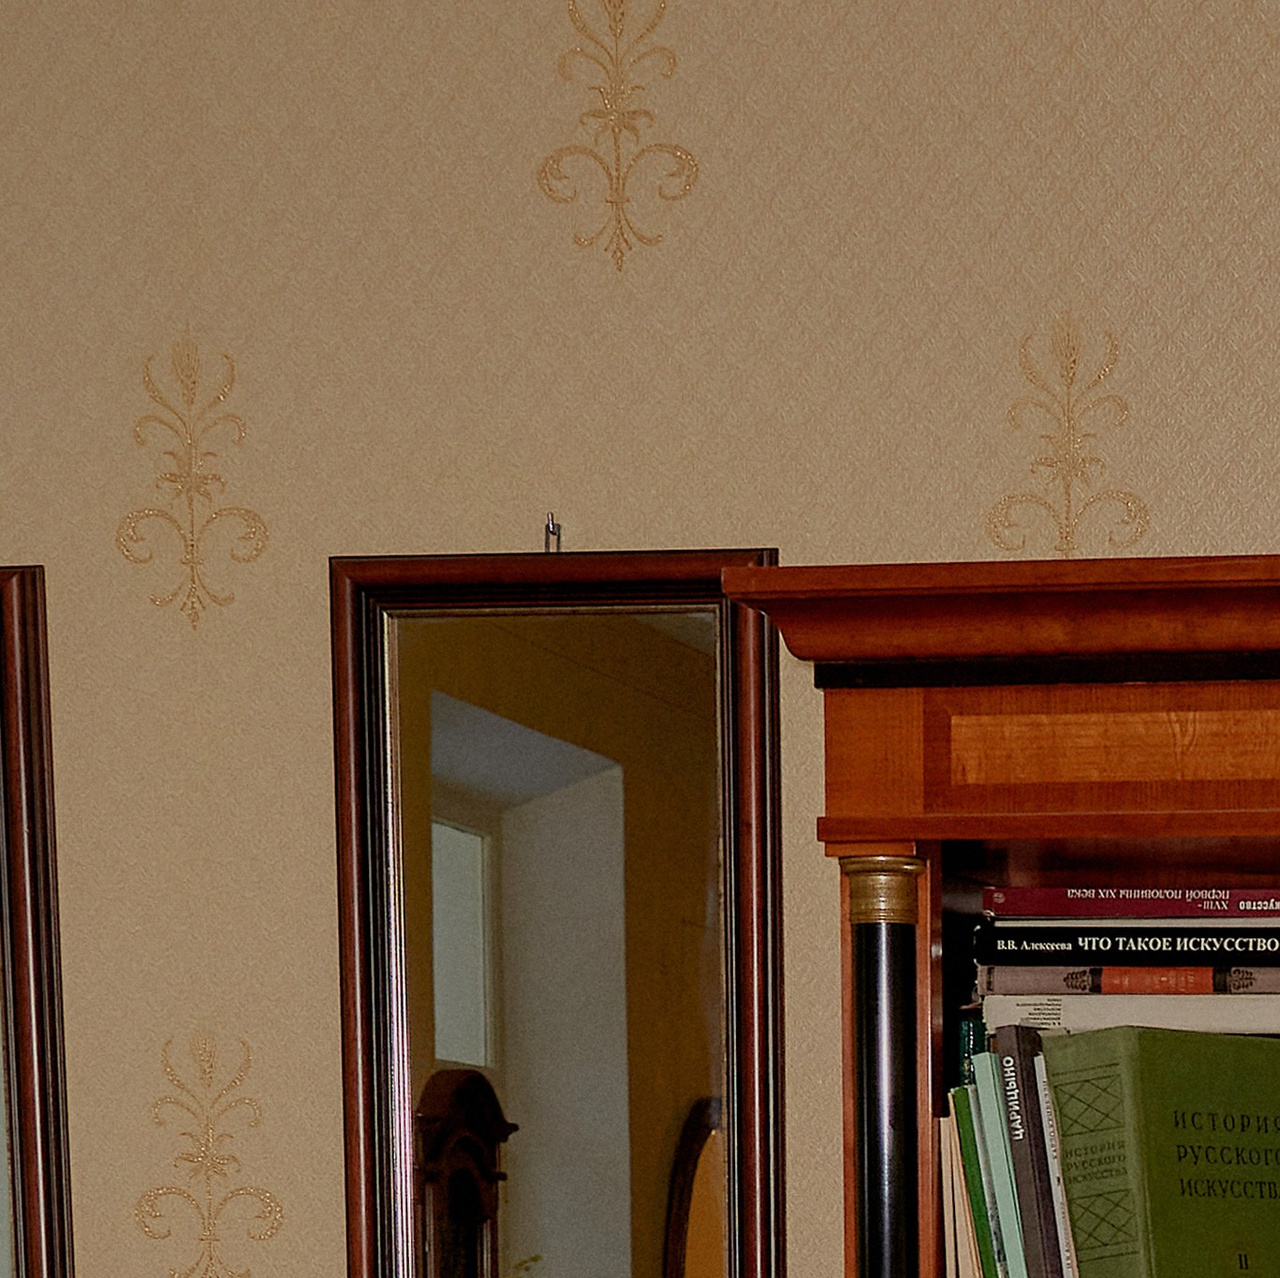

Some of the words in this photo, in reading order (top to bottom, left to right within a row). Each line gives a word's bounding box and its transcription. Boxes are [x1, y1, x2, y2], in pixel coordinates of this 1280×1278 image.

[1077, 936, 1112, 952] ЧТО
[1115, 936, 1172, 952] ТАКОЕ
[1002, 1054, 1025, 1141] ЦАРИЦЫНО
